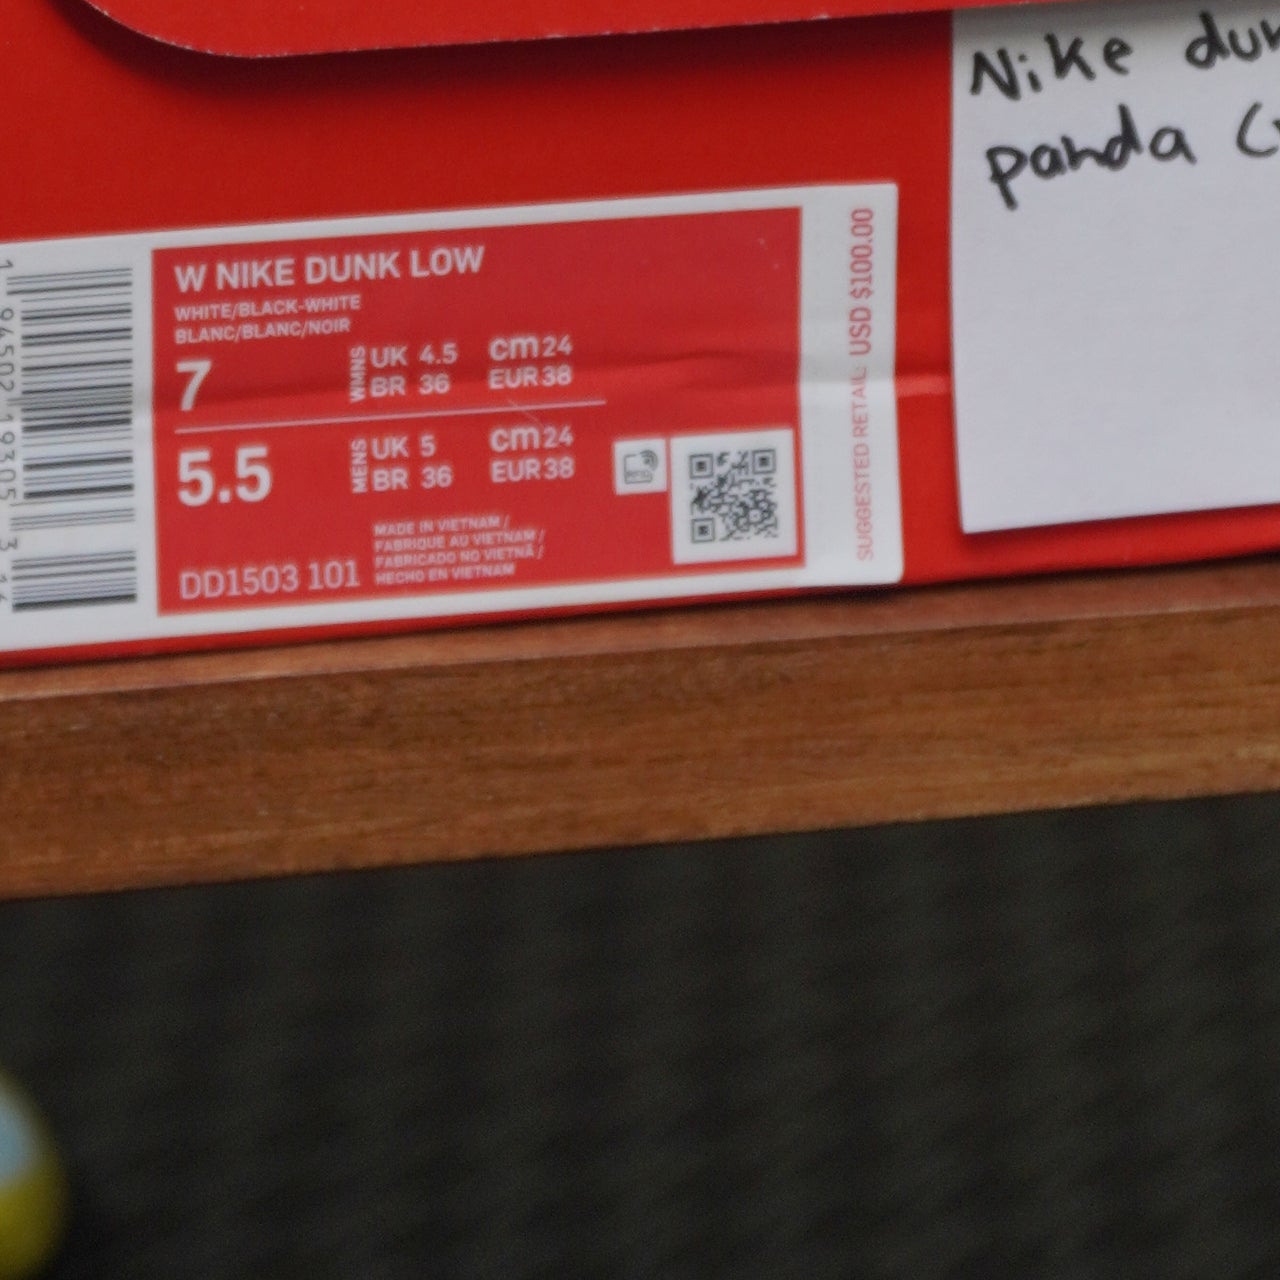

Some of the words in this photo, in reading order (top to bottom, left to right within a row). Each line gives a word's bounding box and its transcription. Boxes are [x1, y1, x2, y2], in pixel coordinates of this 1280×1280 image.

[970, 33, 1133, 100] Nike
[985, 102, 1198, 211] panda
[174, 264, 207, 293] W
[216, 257, 296, 290] NIKE
[305, 250, 401, 284] DUNK
[410, 245, 485, 278] LOW
[848, 207, 874, 300] $100.00
[174, 294, 361, 322] WHITE/BLACK-WHITE
[174, 317, 352, 345] BLANC/BLANC/NOIR
[848, 306, 872, 356] USD
[349, 345, 366, 404] WMNS
[370, 345, 408, 368] UK
[419, 342, 458, 365] 4.5
[176, 359, 212, 412] 7
[370, 375, 406, 398] BR
[419, 373, 451, 395] 36
[351, 438, 369, 494] MENS
[371, 435, 409, 460] UK
[420, 433, 436, 458] 5
[177, 445, 272, 507] 5.5
[372, 467, 409, 491] BR
[421, 465, 453, 489] 36
[853, 443, 874, 561] SUGGESTED
[374, 522, 415, 536] MADE
[420, 520, 434, 533] IN
[438, 515, 500, 532] VIETNAM
[473, 528, 536, 545] VIETNAM
[179, 562, 300, 600] DD1503
[308, 559, 361, 590] 101
[451, 561, 516, 580] VIETNAM
